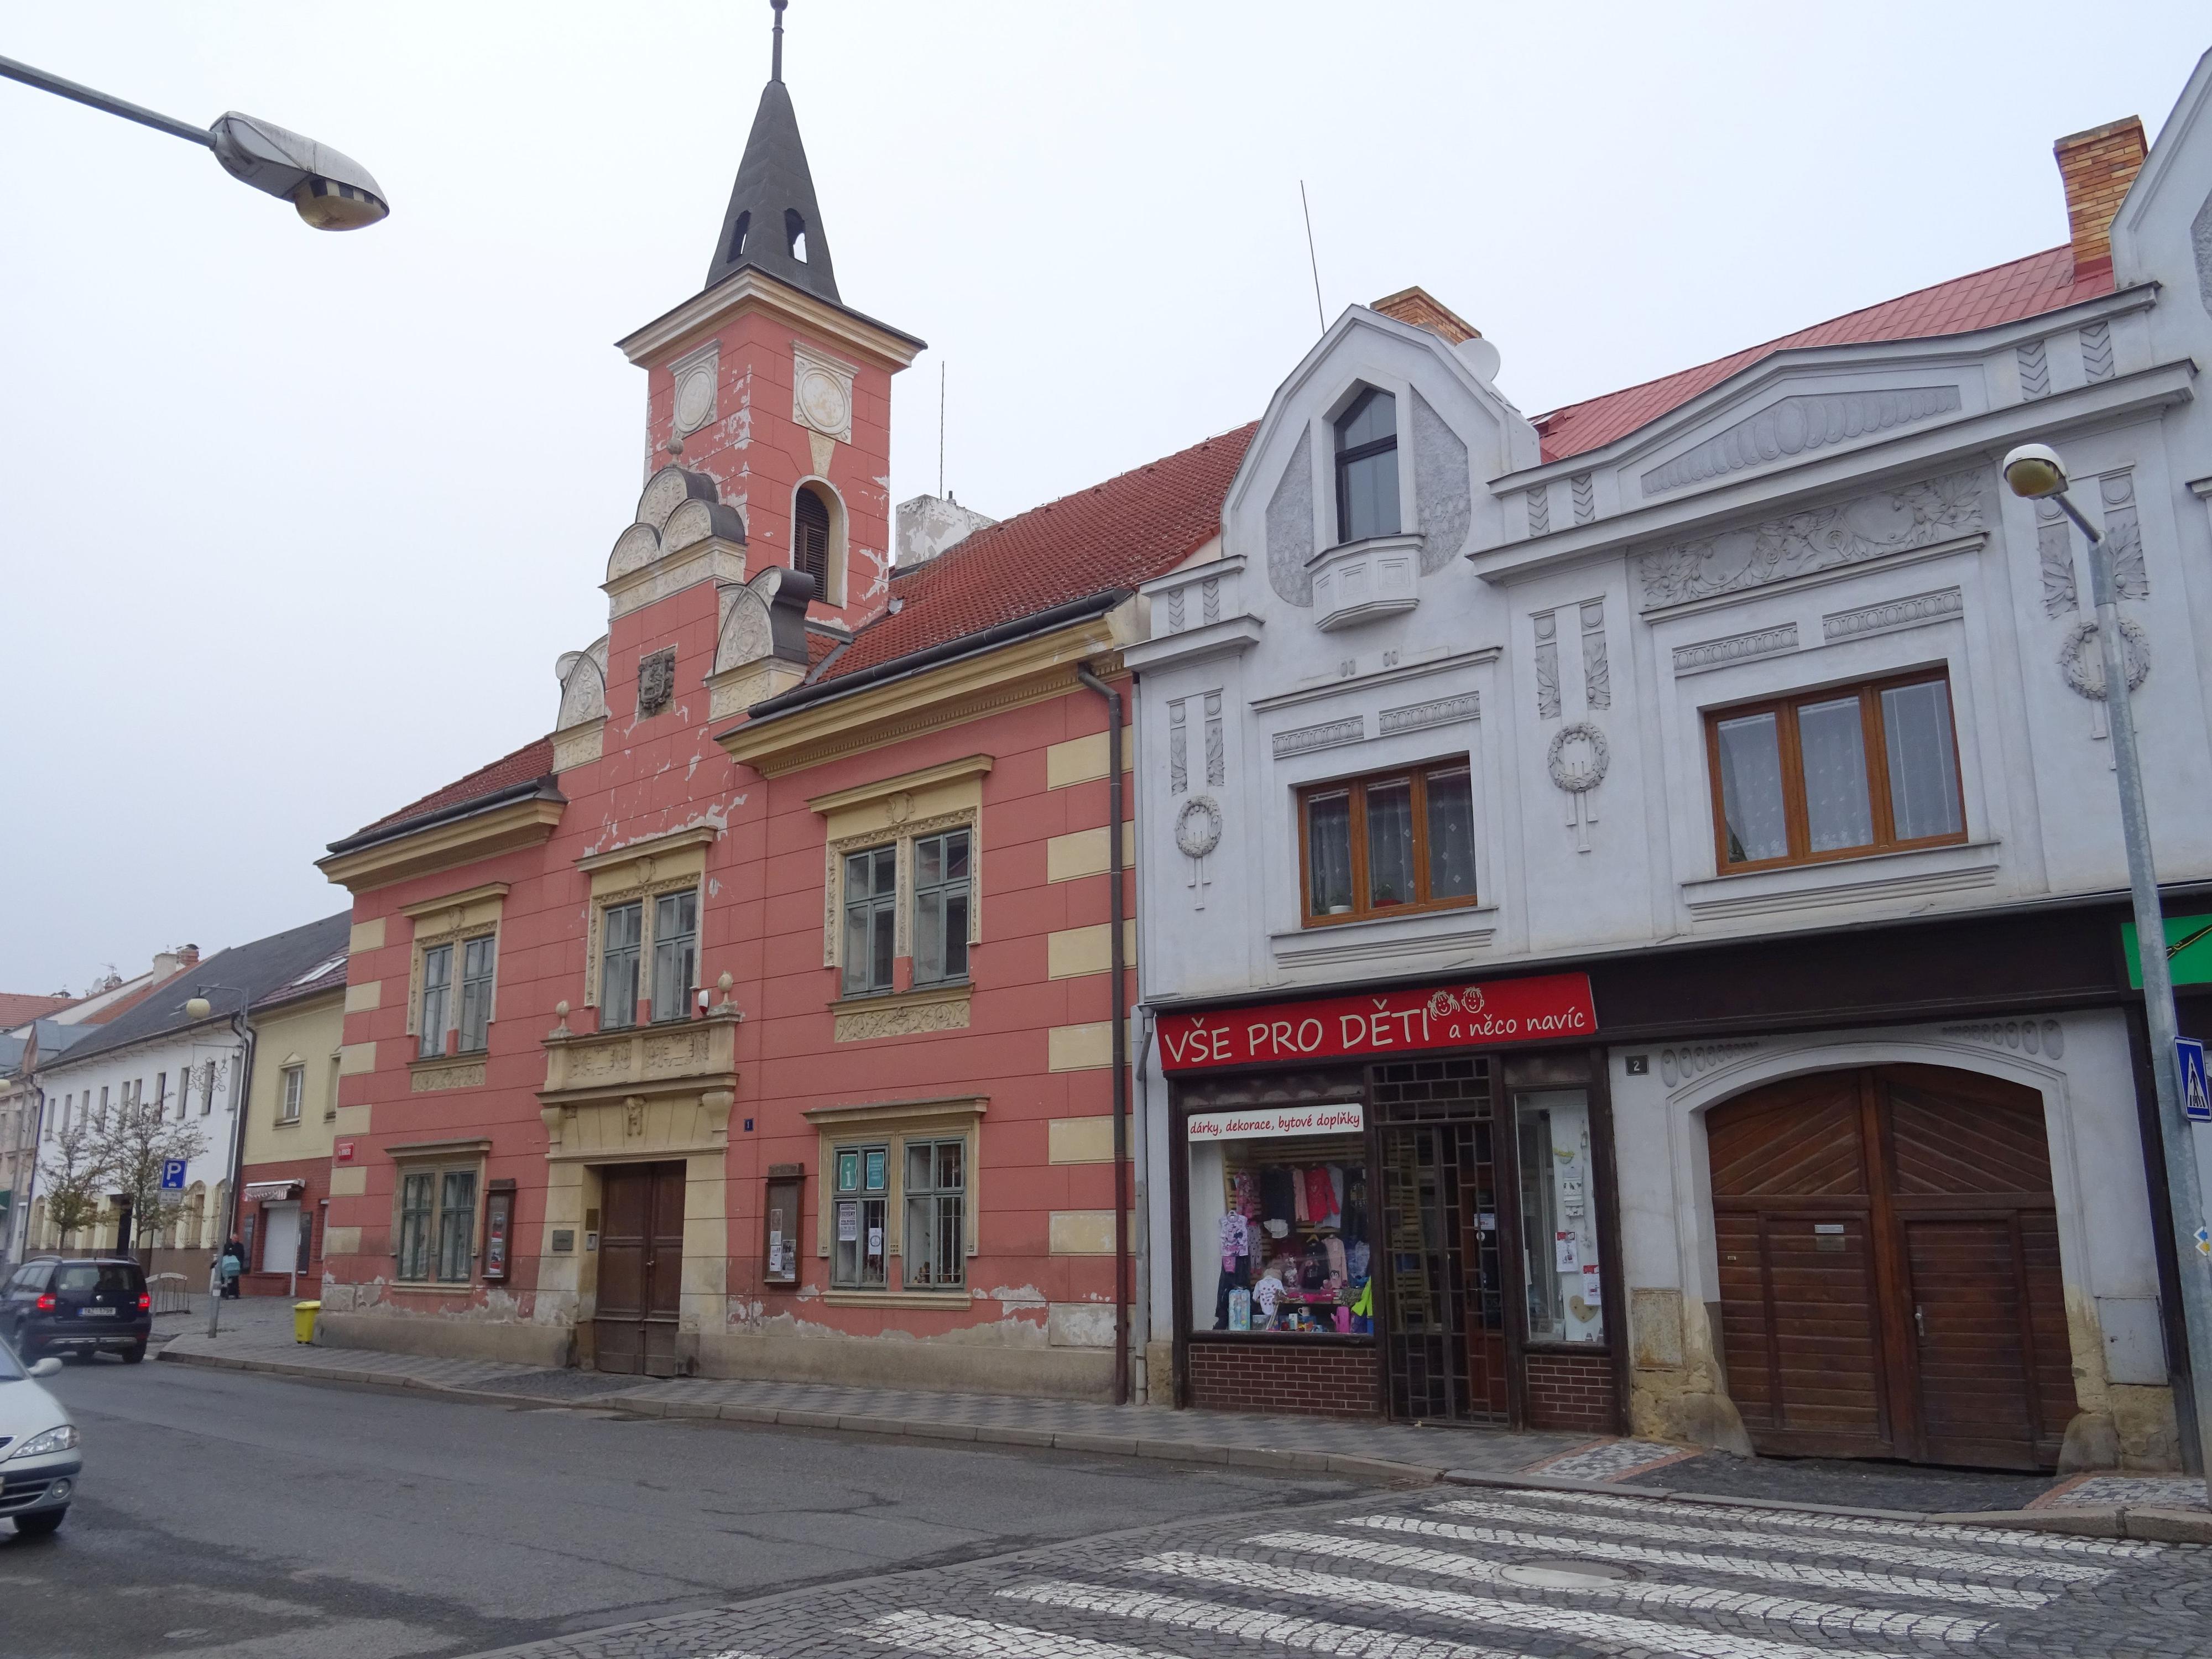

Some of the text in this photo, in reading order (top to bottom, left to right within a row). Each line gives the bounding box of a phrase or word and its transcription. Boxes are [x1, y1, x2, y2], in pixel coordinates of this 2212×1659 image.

[1165, 998, 1585, 1063] VŠE PRO DĚTI a něco navíc
[1633, 1060, 1640, 1071] 2
[1190, 1111, 1360, 1136] dárky, dekorace, bytové doplňky
[166, 1162, 182, 1181] P
[846, 1162, 852, 1187] i
